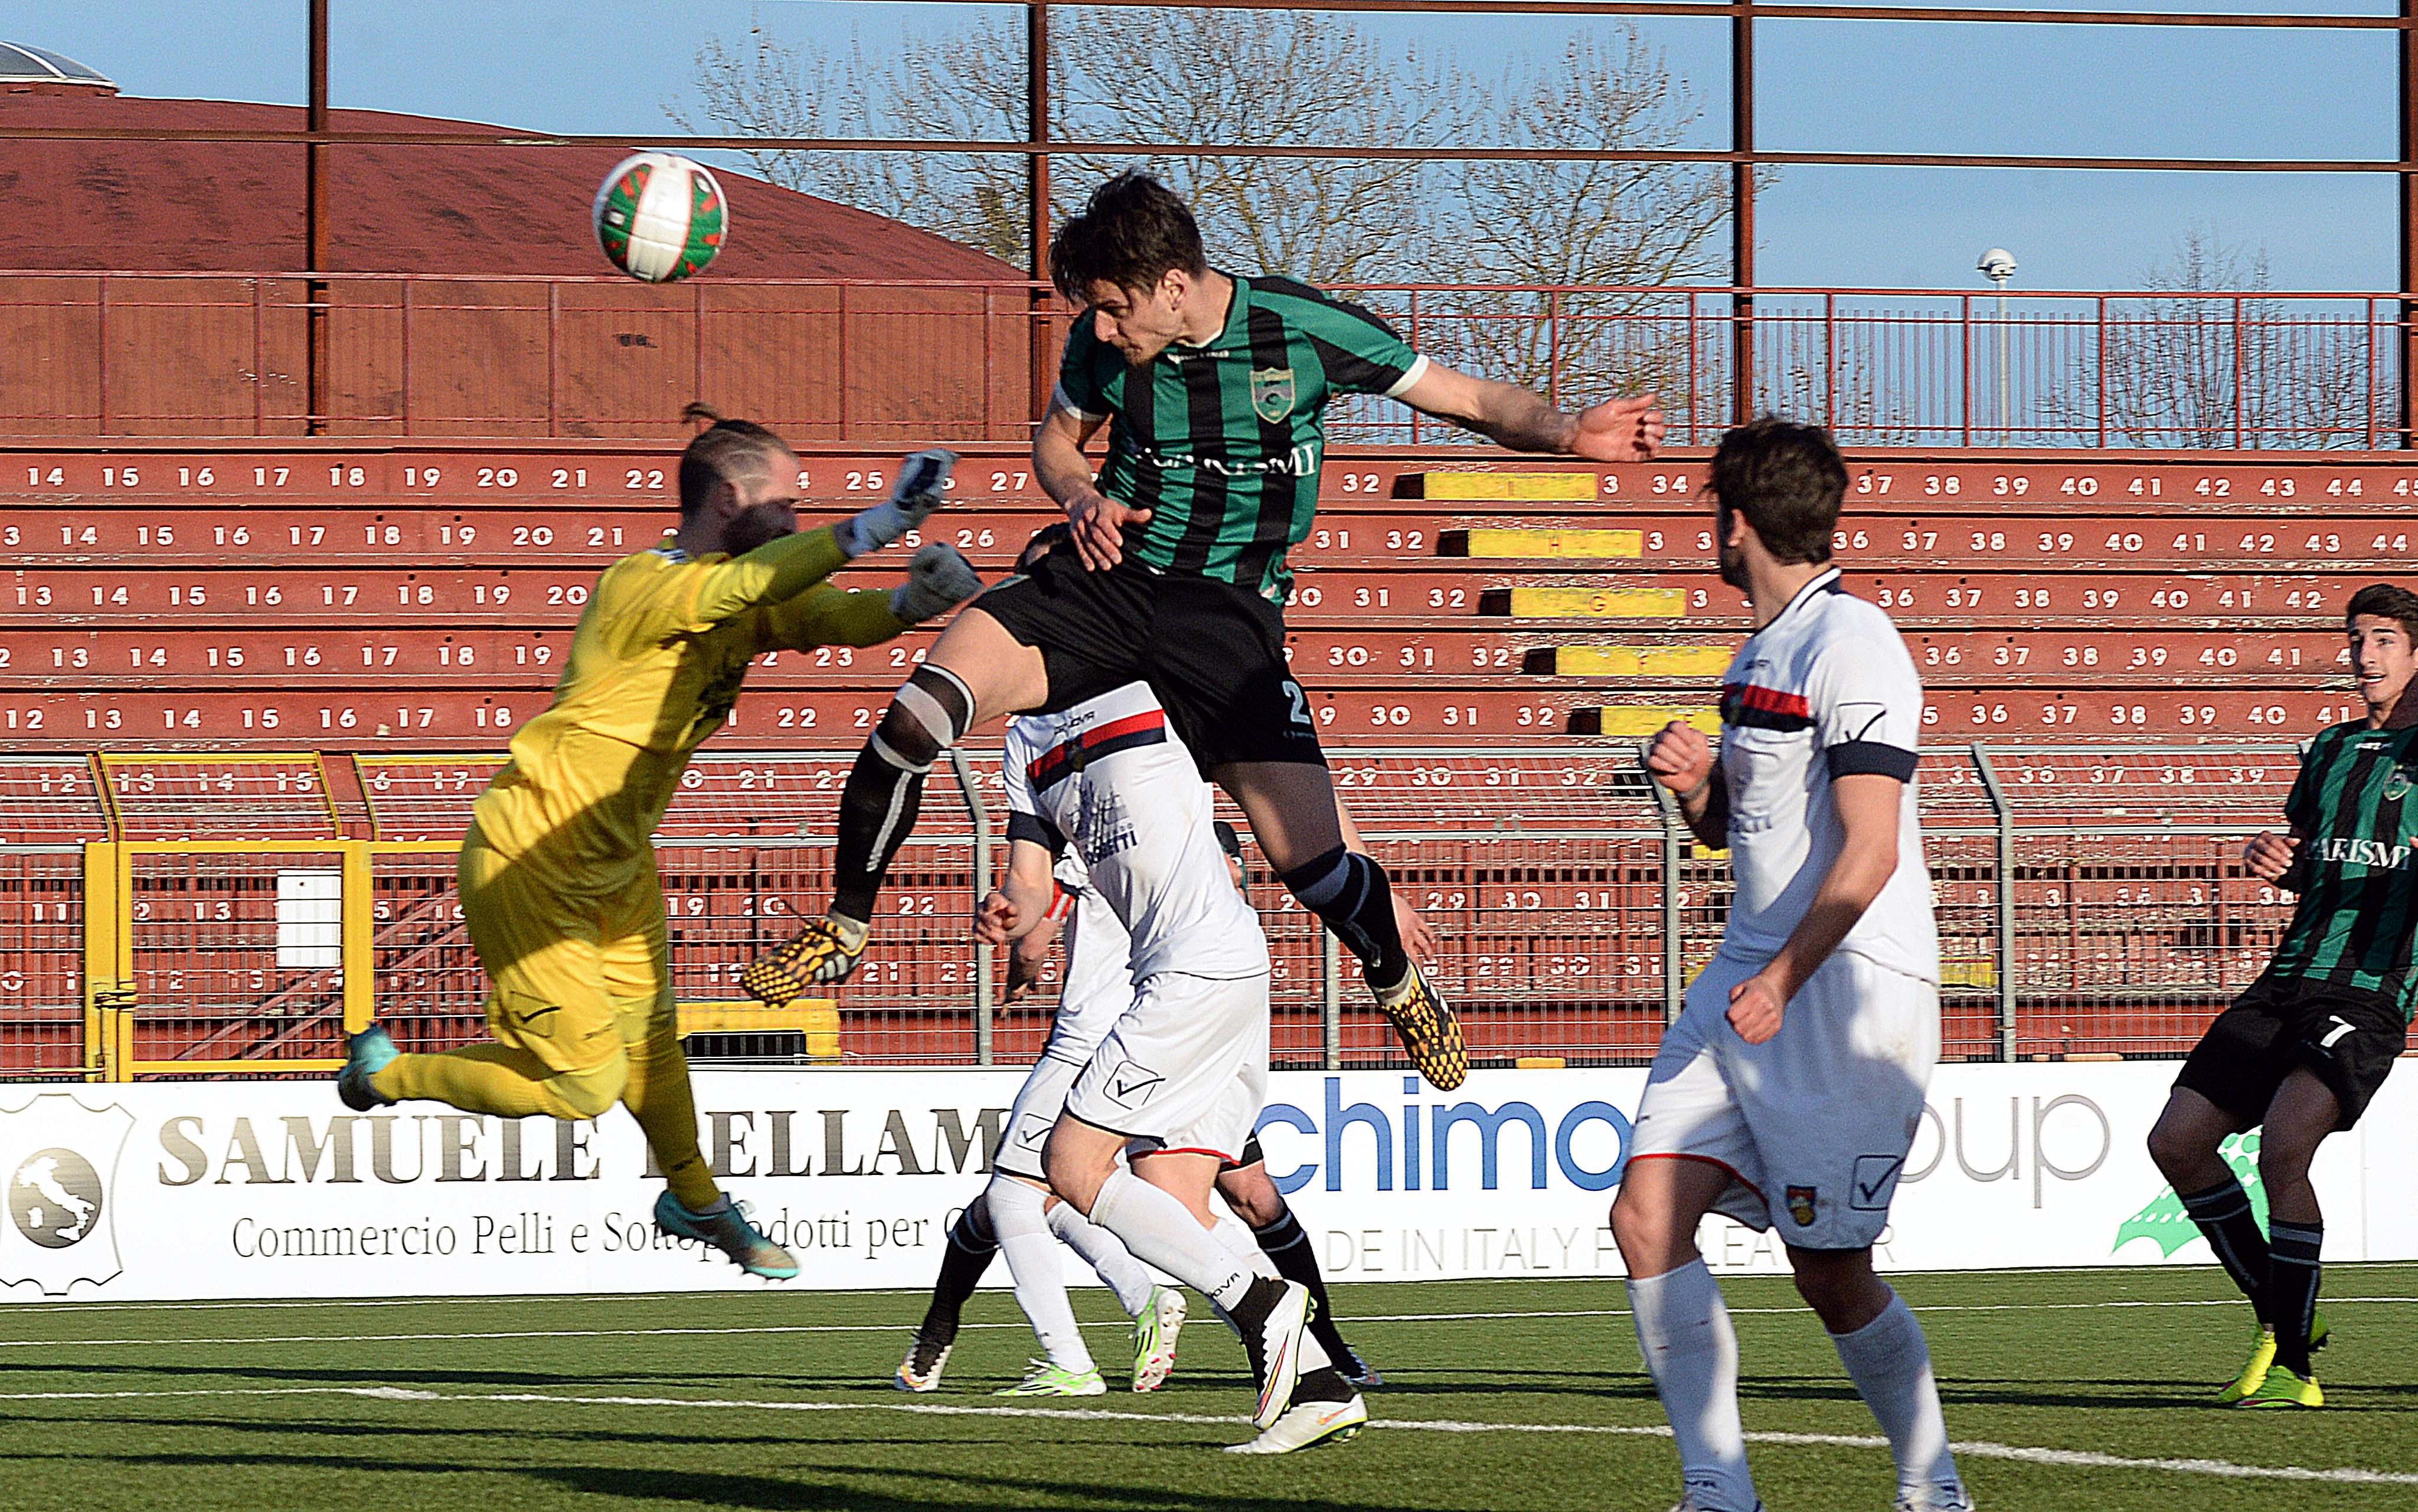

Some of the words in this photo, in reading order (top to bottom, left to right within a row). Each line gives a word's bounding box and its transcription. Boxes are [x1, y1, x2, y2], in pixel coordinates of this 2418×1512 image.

[28, 467, 64, 486] 14
[103, 467, 139, 486] 15
[178, 467, 214, 486] 16
[253, 467, 290, 486] 17
[329, 467, 365, 486] 18
[404, 468, 440, 487] 19
[477, 468, 518, 487] 20
[551, 469, 586, 488] 21
[626, 470, 664, 489] 22
[845, 472, 884, 490] 25
[991, 472, 1028, 491] 27
[1342, 474, 1379, 492] 32
[1603, 475, 1619, 493] 3
[1652, 475, 1688, 493] 34
[1857, 475, 1893, 494] 37
[1924, 476, 1960, 495] 38
[1993, 476, 2029, 495] 39
[2060, 477, 2098, 496] 40
[2128, 478, 2161, 496] 41
[2194, 478, 2230, 496] 42
[2260, 479, 2295, 496] 43
[2326, 479, 2363, 496] 44
[4, 526, 20, 545] 3
[61, 526, 98, 545] 14
[137, 526, 174, 545] 15
[213, 526, 250, 545] 16
[289, 526, 325, 545] 17
[365, 526, 400, 545] 18
[440, 526, 476, 545] 19
[512, 527, 553, 545] 20
[587, 527, 623, 546] 21
[957, 529, 994, 548] 26
[1315, 530, 1349, 549] 31
[1386, 531, 1423, 549] 32
[1648, 532, 1664, 550] 3
[1832, 531, 1868, 549] 36
[1902, 532, 1937, 551] 37
[1970, 532, 2005, 551] 38
[2038, 533, 2073, 551] 39
[2105, 534, 2143, 551] 40
[2172, 534, 2205, 551] 41
[2239, 535, 2275, 552] 42
[2305, 535, 2340, 552] 43
[2371, 535, 2408, 552] 44
[15, 587, 52, 606] 13
[92, 587, 129, 606] 14
[169, 587, 206, 606] 15
[245, 586, 282, 605] 16
[322, 586, 358, 605] 17
[398, 586, 434, 604] 18
[474, 585, 510, 605] 19
[547, 586, 588, 605] 20
[1354, 588, 1388, 607] 31
[1429, 588, 1465, 607] 32
[1692, 590, 1708, 608] 3
[1878, 588, 1914, 607] 36
[1946, 588, 1982, 607] 37
[2014, 589, 2050, 607] 38
[2083, 590, 2119, 608] 39
[2151, 590, 2189, 608] 40
[2218, 591, 2252, 608] 41
[2285, 591, 2322, 608] 42
[1589, 595, 1607, 612] G
[0, 648, 11, 667] 2
[51, 648, 89, 667] 13
[130, 648, 168, 667] 14
[207, 647, 244, 666] 15
[284, 647, 321, 666] 16
[361, 647, 398, 666] 17
[438, 647, 474, 666] 18
[515, 646, 551, 665] 19
[815, 647, 853, 666] 23
[890, 648, 927, 667] 24
[1328, 647, 1368, 666] 30
[1400, 647, 1433, 666] 31
[1472, 647, 1509, 666] 32
[1924, 646, 1961, 665] 36
[1994, 647, 2030, 665] 37
[2063, 647, 2099, 666] 38
[2131, 647, 2168, 666] 39
[2198, 648, 2237, 666] 40
[2267, 648, 2301, 666] 41
[5, 709, 43, 729] 12
[85, 709, 122, 729] 13
[163, 709, 201, 728] 14
[241, 709, 279, 728] 15
[319, 708, 357, 728] 16
[397, 708, 434, 728] 17
[475, 708, 511, 727] 18
[778, 708, 816, 727] 22
[1319, 706, 1336, 725] 9
[1371, 706, 1410, 725] 30
[1443, 706, 1477, 725] 31
[1517, 707, 1557, 725] 32
[1922, 706, 1939, 725] 5
[1971, 705, 2008, 724] 36
[2041, 705, 2077, 724] 37
[2110, 706, 2146, 724] 38
[2180, 706, 2216, 725] 39
[2247, 706, 2286, 725] 40
[2316, 706, 2350, 725] 41
[40, 773, 76, 793] 12
[118, 773, 155, 792] 13
[198, 773, 234, 792] 14
[276, 772, 313, 791] 15
[432, 772, 468, 791] 17
[739, 770, 775, 788] 21
[1340, 767, 1377, 786] 29
[1411, 767, 1452, 786] 30
[1485, 767, 1519, 786] 31
[1561, 767, 1597, 786] 32
[32, 903, 67, 921] 11
[194, 902, 231, 921] 13
[668, 898, 703, 916] 19
[898, 896, 934, 915] 22
[1575, 891, 1609, 909] 31
[863, 963, 898, 981] 21
[2320, 1014, 2357, 1049] 7
[158, 1115, 600, 1186] SAMUELE
[641, 1108, 1012, 1179] ELLAM
[232, 1216, 457, 1257] Commercio
[472, 1212, 556, 1254] Pelli
[570, 1222, 590, 1253] e
[864, 1215, 929, 1262] per
[1327, 1230, 1383, 1272] DE
[1402, 1229, 1445, 1271] IN
[1463, 1227, 1579, 1270] ITALY
